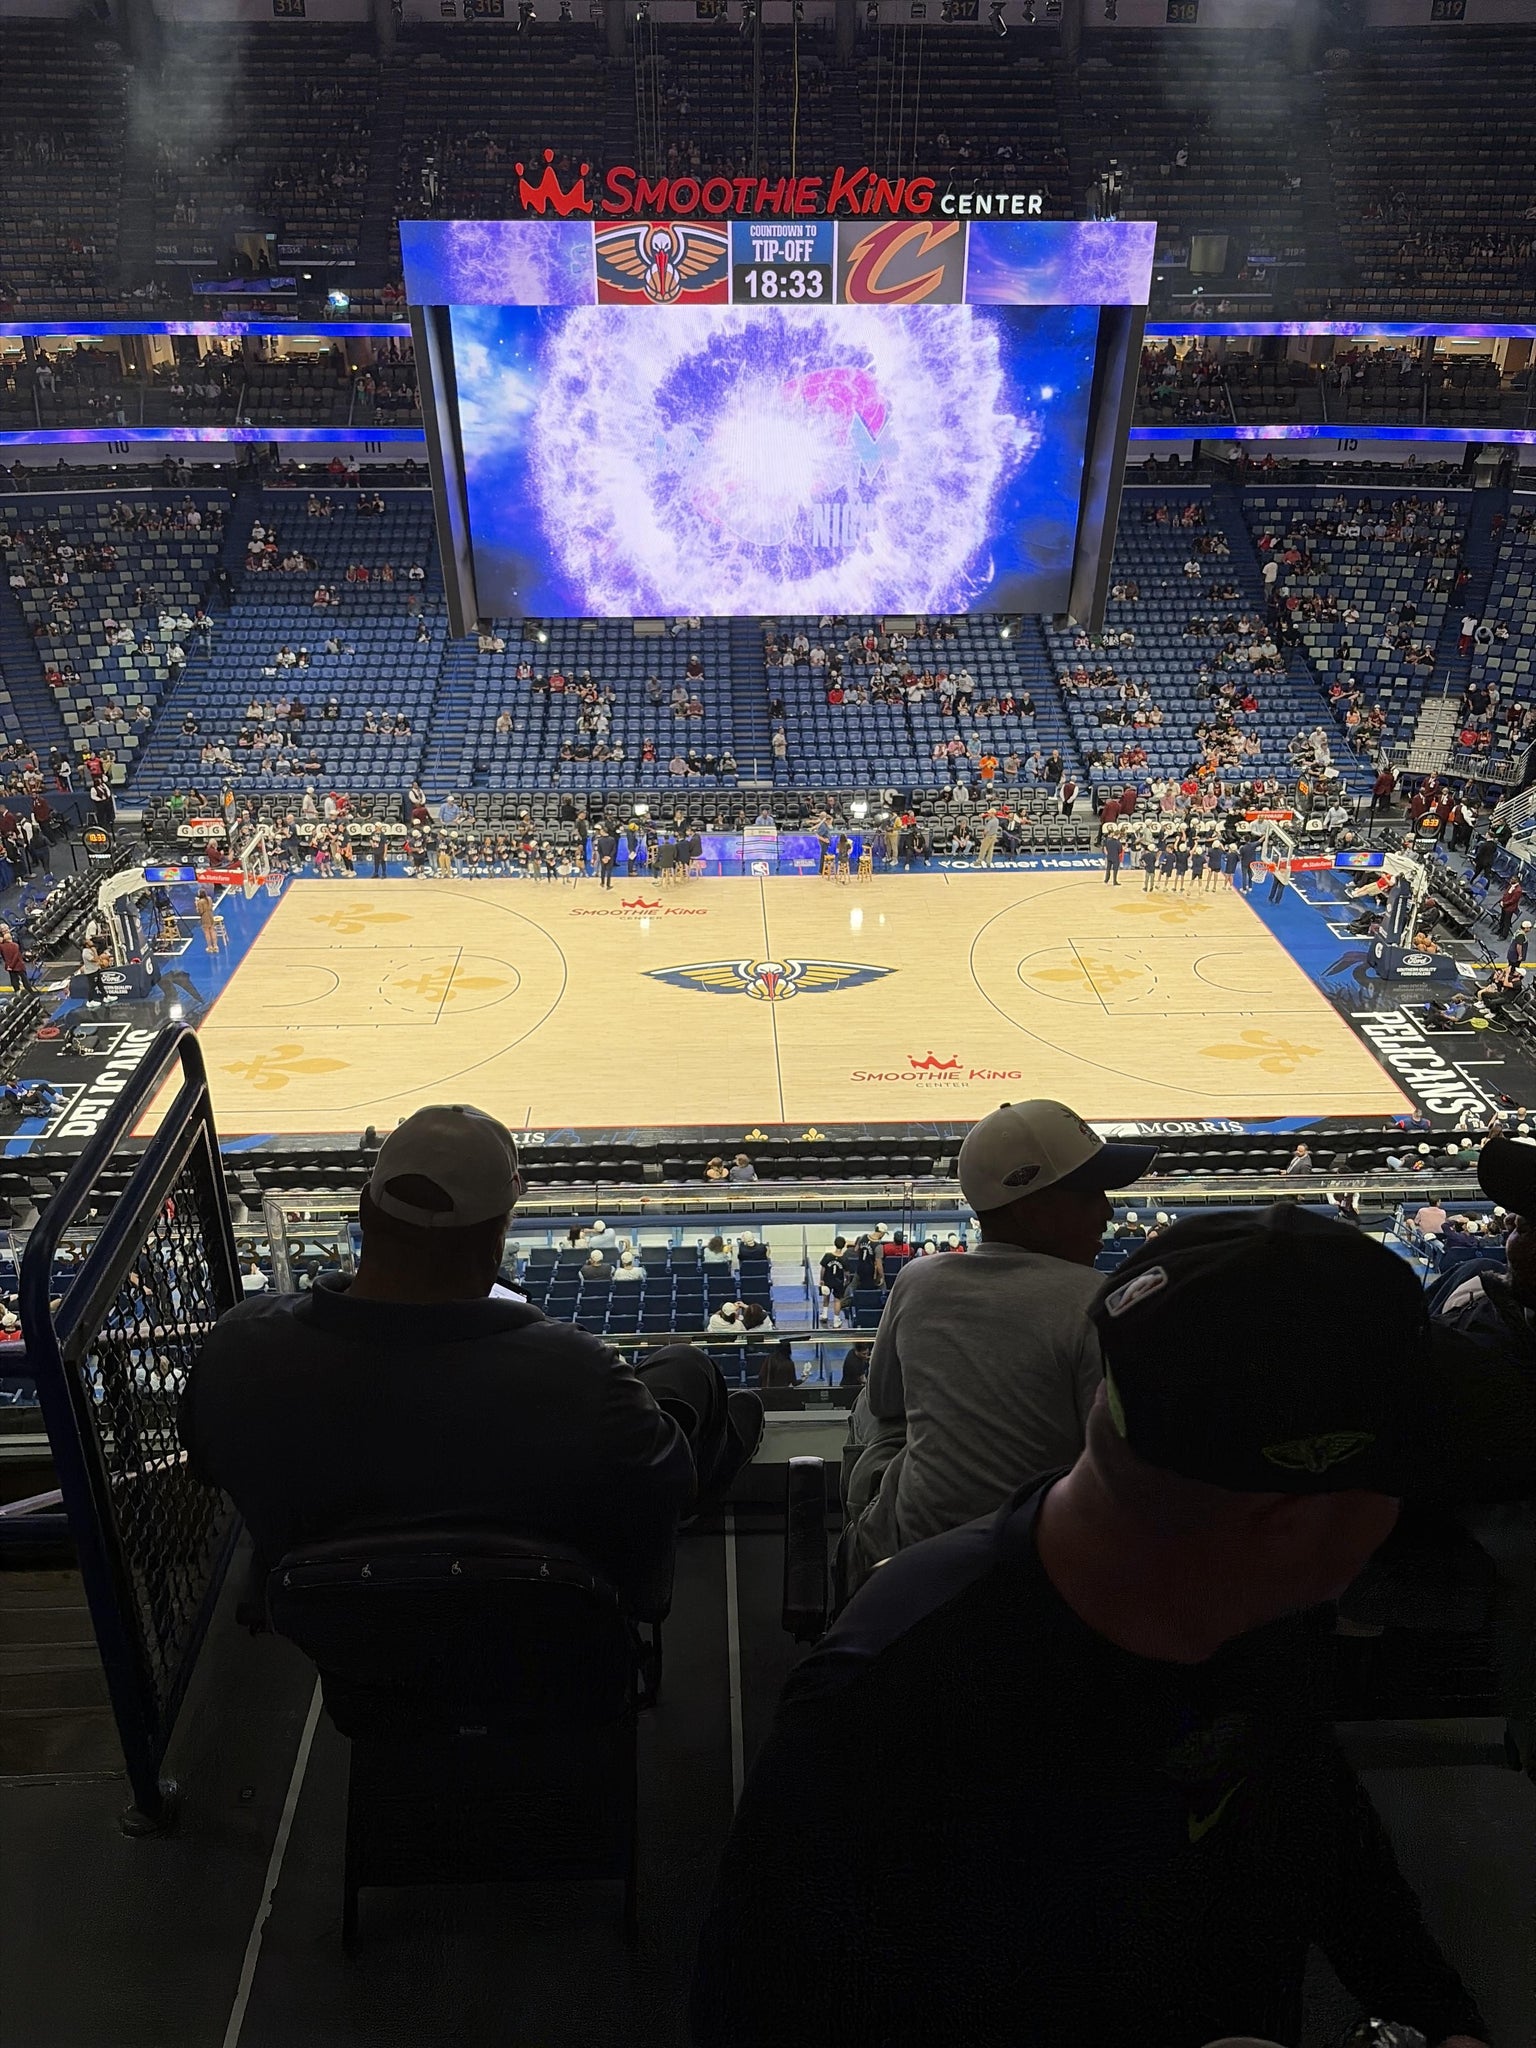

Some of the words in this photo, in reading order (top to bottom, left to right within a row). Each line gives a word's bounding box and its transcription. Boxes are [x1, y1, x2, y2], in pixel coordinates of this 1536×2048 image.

[601, 166, 822, 214] SMOOTHIE
[940, 194, 1043, 215] CENTER
[750, 225, 802, 237] COUNTDOWN
[805, 225, 817, 237] TO
[752, 240, 814, 262] TIP-OFF
[744, 269, 823, 298] 18:33
[569, 908, 659, 916] SMOOTHIE
[1350, 1010, 1487, 1114] PELICANS
[850, 1070, 960, 1082] SMOOTHIE
[1137, 1121, 1244, 1134] MORRIS
[511, 1132, 545, 1144] RIS
